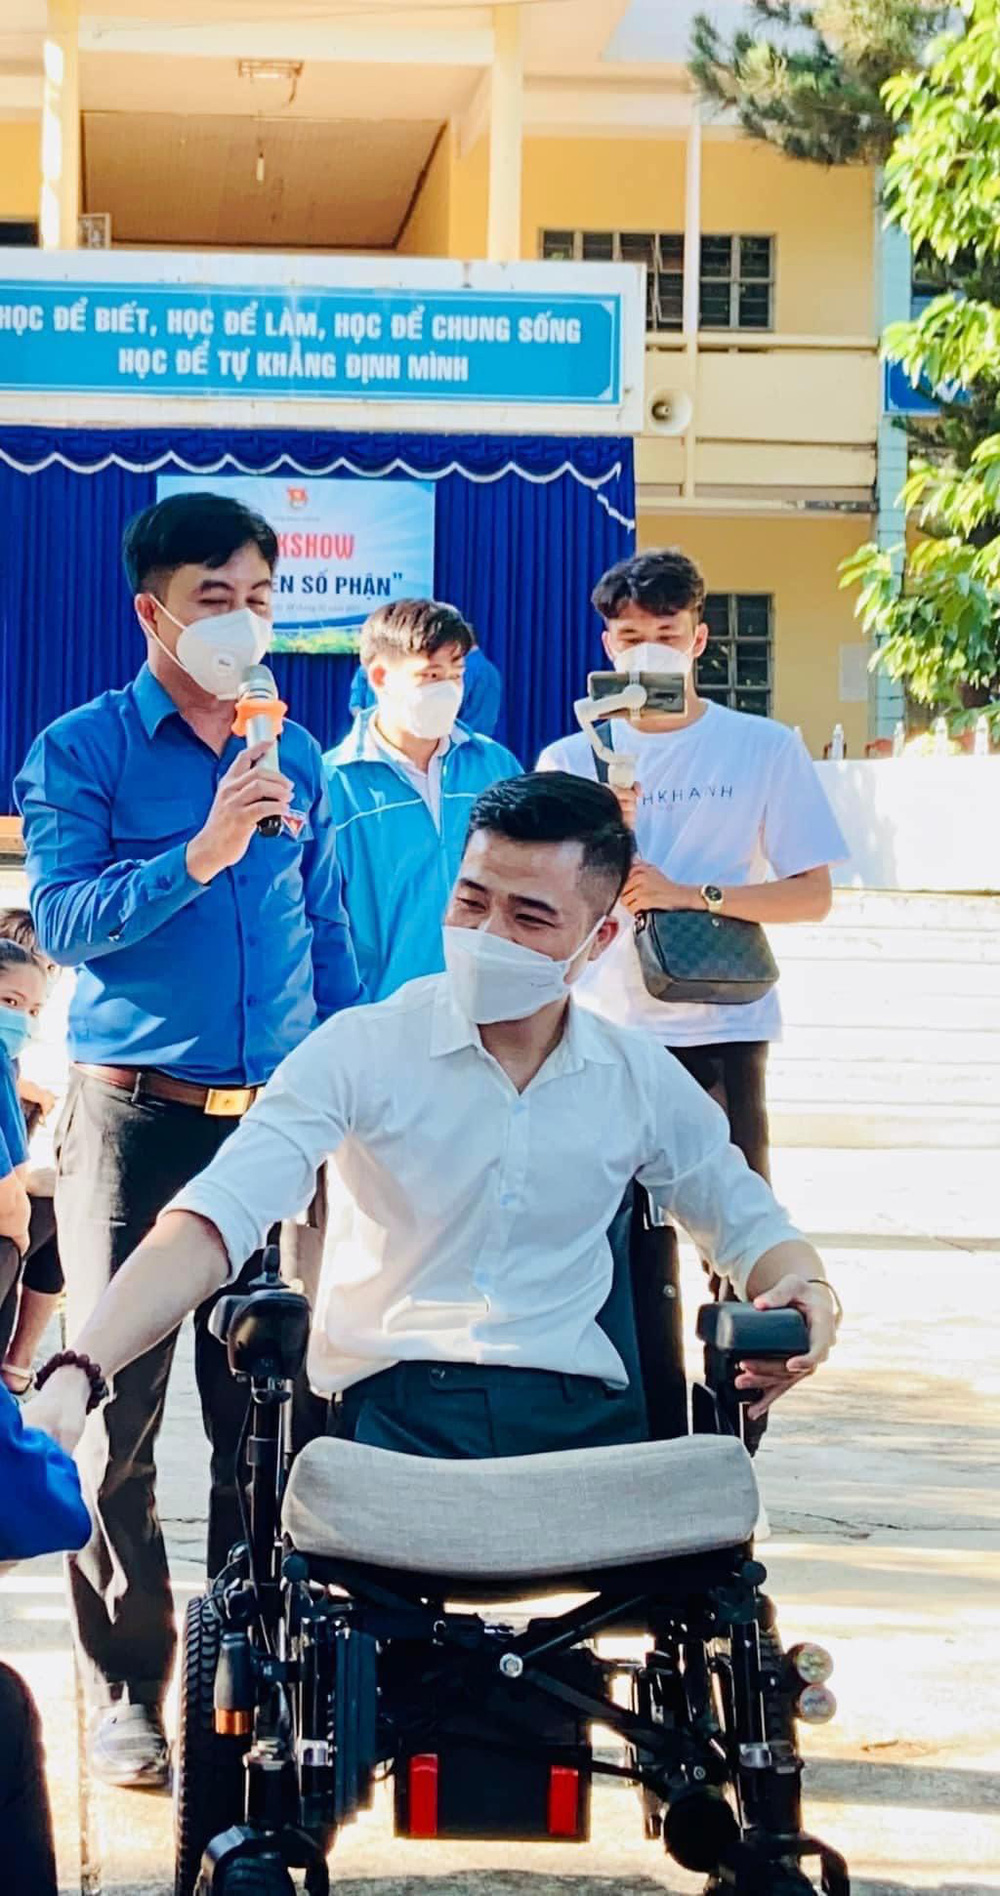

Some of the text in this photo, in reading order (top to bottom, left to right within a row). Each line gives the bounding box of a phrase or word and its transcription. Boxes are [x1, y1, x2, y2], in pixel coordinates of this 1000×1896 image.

[53, 296, 89, 332] ĐỂ
[94, 300, 157, 337] BIẾT,
[166, 308, 214, 341] HỌC
[223, 300, 258, 337] ĐỂ
[265, 306, 326, 341] LÀM,
[334, 312, 381, 344] HỌC
[391, 304, 426, 340] ĐỂ
[432, 314, 511, 343] CHUNG
[518, 310, 581, 344] SỐNG
[118, 347, 168, 380] HỌC
[175, 339, 211, 375] ĐỂ
[218, 347, 250, 382] TỰ
[345, 351, 400, 384] ĐỊNH
[407, 349, 469, 382] MÌNH
[302, 568, 328, 594] SỐ
